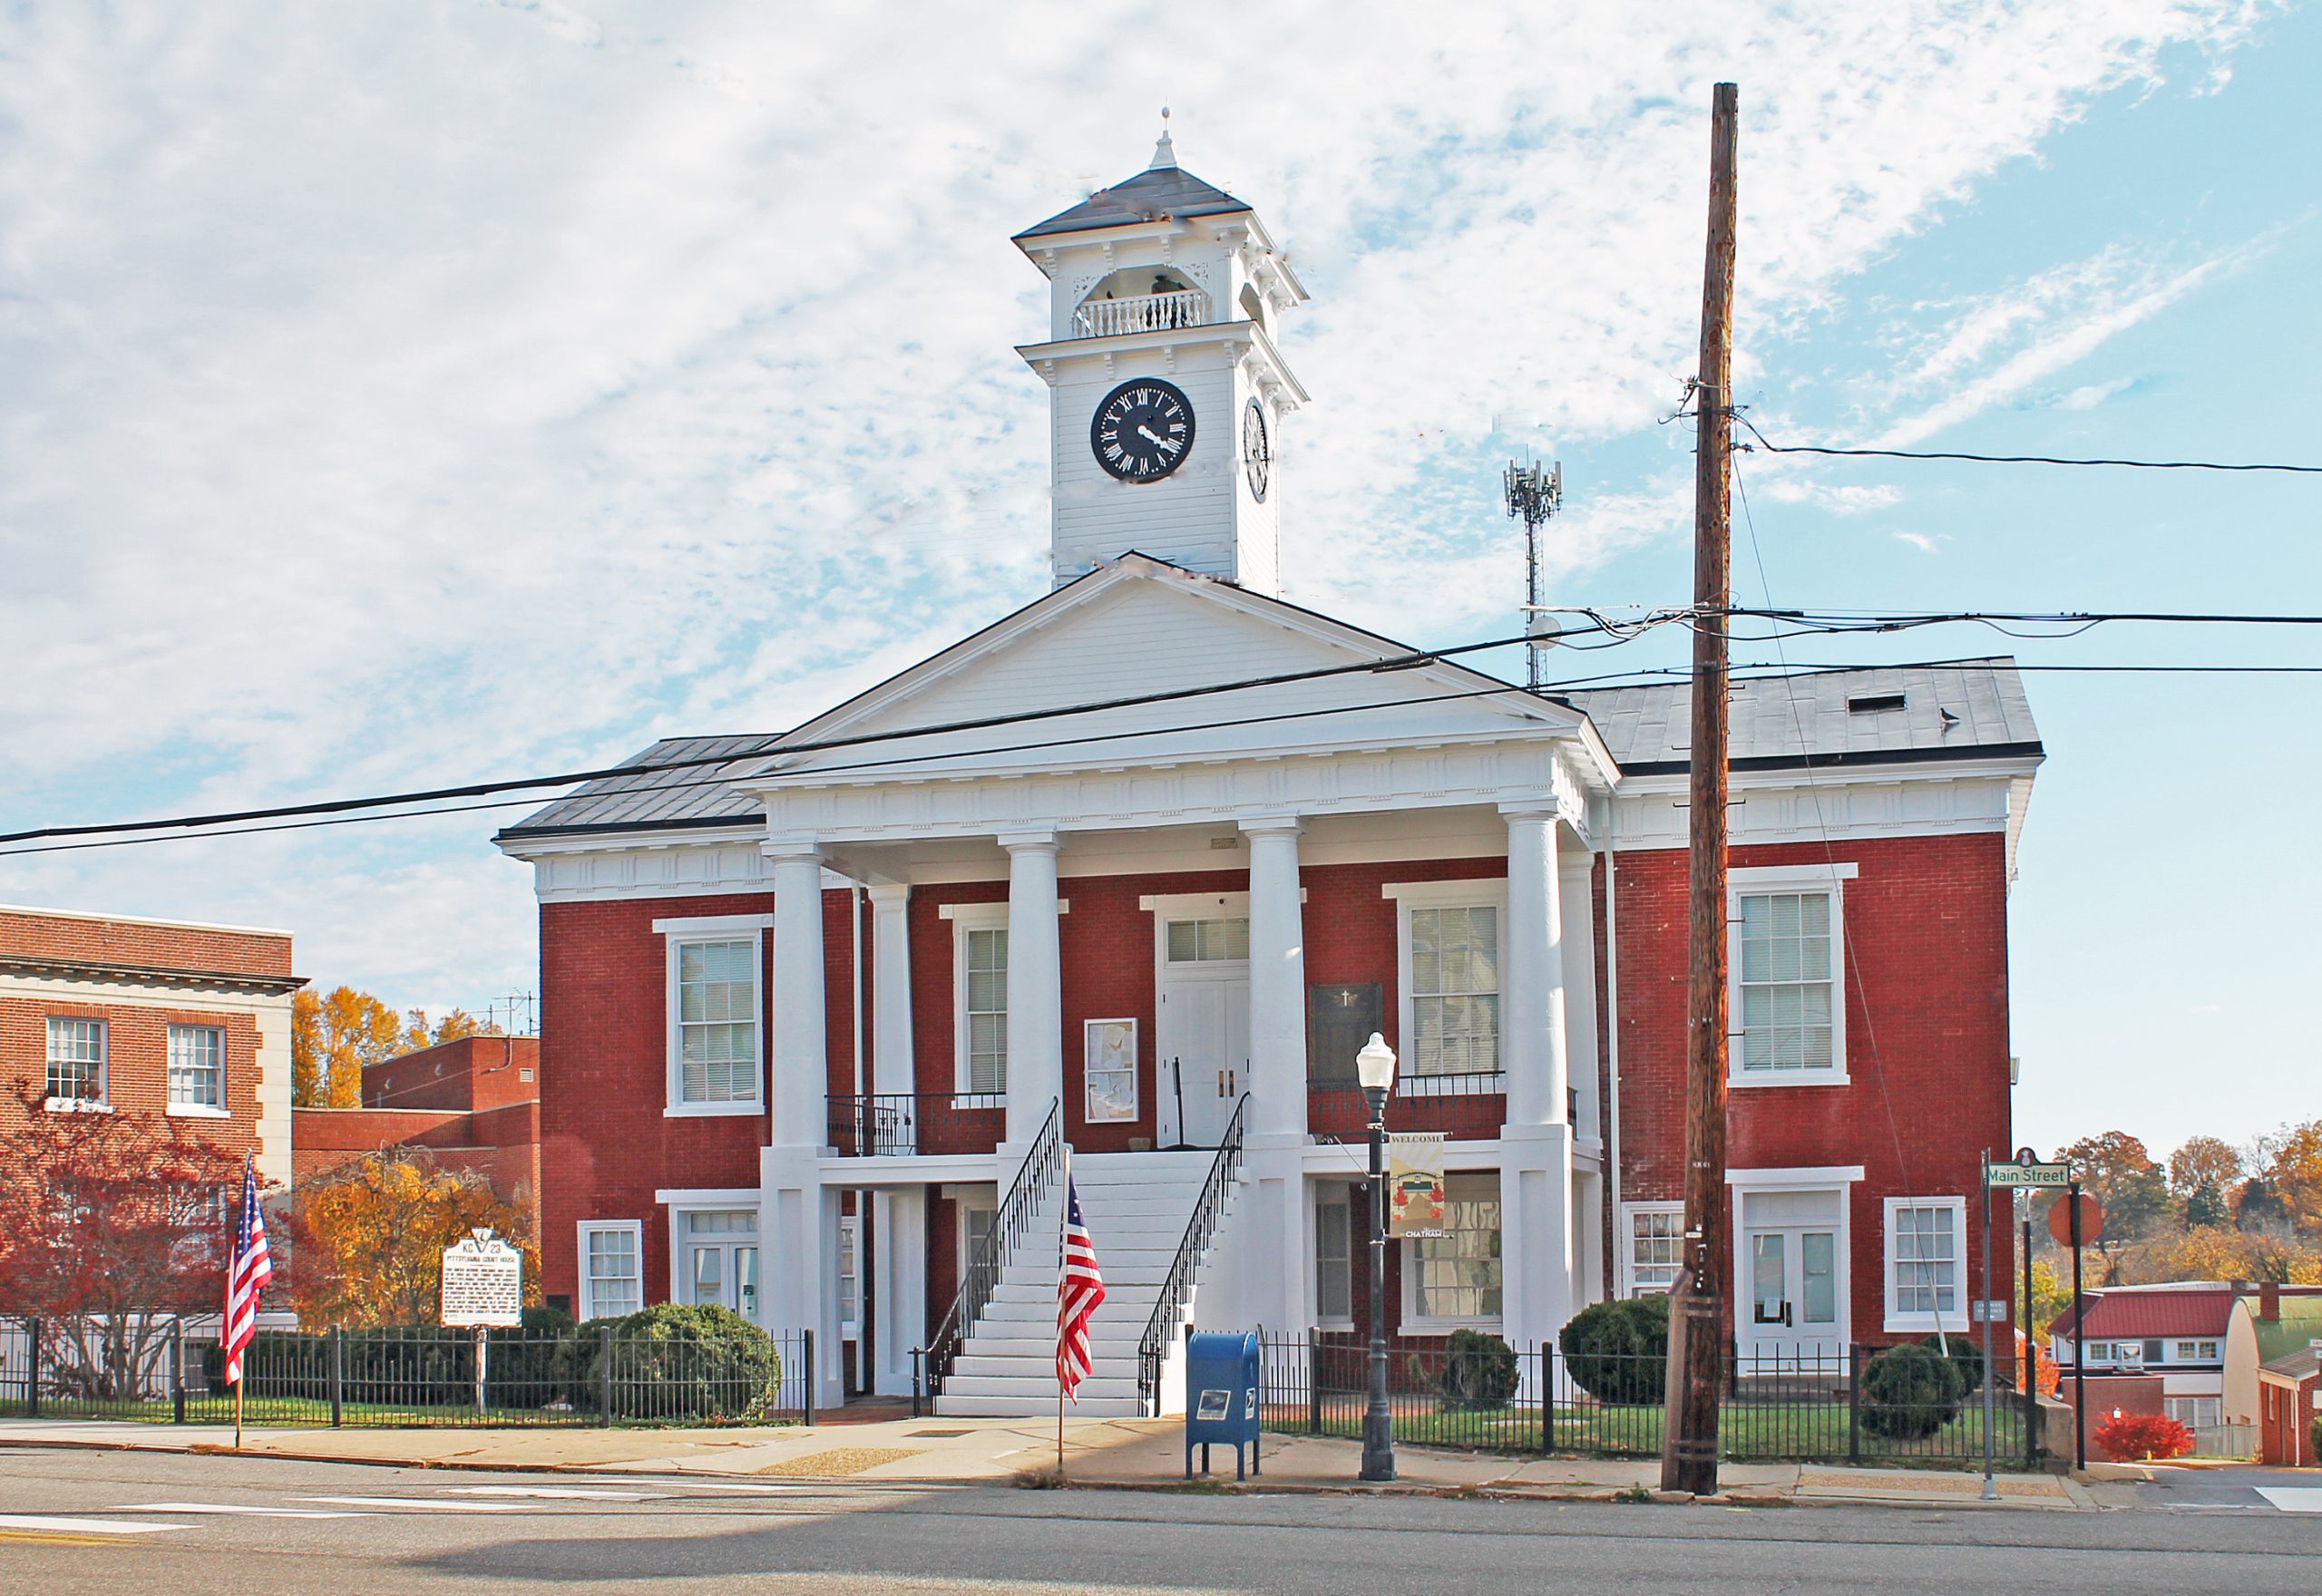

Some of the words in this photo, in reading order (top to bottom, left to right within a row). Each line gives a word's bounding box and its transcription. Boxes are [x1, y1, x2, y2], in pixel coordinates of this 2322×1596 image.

[1391, 1135, 1443, 1143] WELCOME
[1989, 1169, 2019, 1182] Main
[2023, 1169, 2065, 1182] Street
[1405, 1230, 1442, 1238] CHATHAM
[463, 1243, 473, 1253] KC
[490, 1243, 501, 1254] 23
